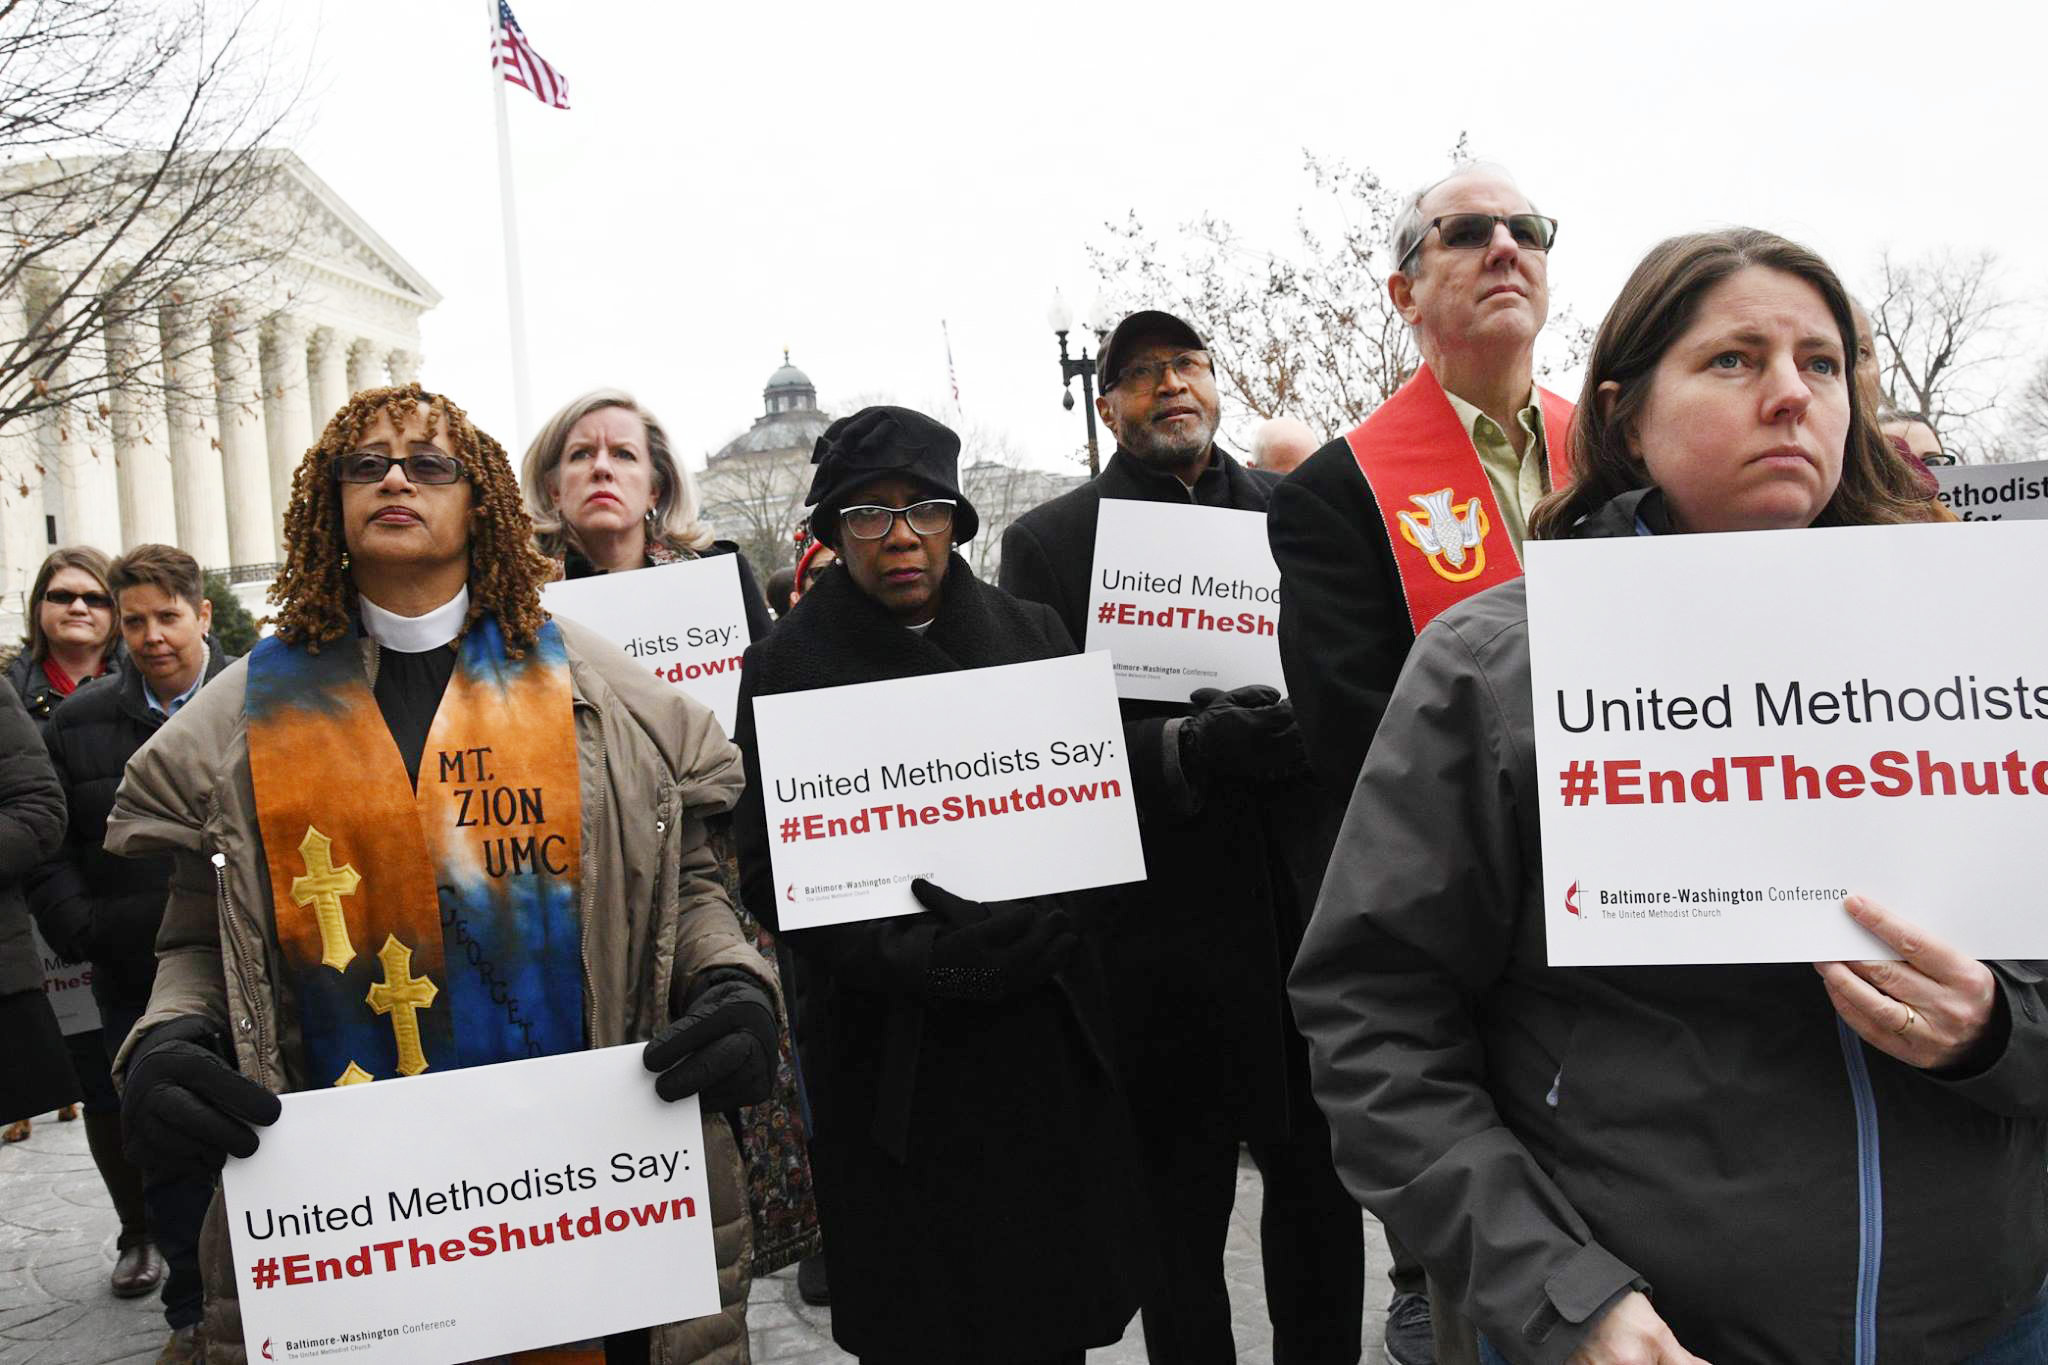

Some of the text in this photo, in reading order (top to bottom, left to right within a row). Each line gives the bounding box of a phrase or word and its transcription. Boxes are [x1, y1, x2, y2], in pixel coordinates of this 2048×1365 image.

[1103, 569, 1182, 594] United
[687, 625, 738, 647] Say:
[1098, 602, 1274, 636] #EndTheSh
[1557, 675, 2048, 733] United Methodists
[438, 747, 495, 783] MT.
[776, 740, 1114, 803] United Methodists Say:
[453, 786, 546, 827] ZION
[780, 779, 1121, 843] #EndTheShutdown
[483, 834, 569, 878] UMC
[804, 877, 891, 895] Baltimore-Washington
[1600, 886, 1847, 905] Baltimore-Washington Conference
[1602, 908, 1722, 920] The United Methodist Church
[245, 1149, 690, 1240] United Methodists Say:
[251, 1196, 696, 1290] #EndTheShutdown
[286, 1318, 457, 1351] Baltimore-Washington Conference
